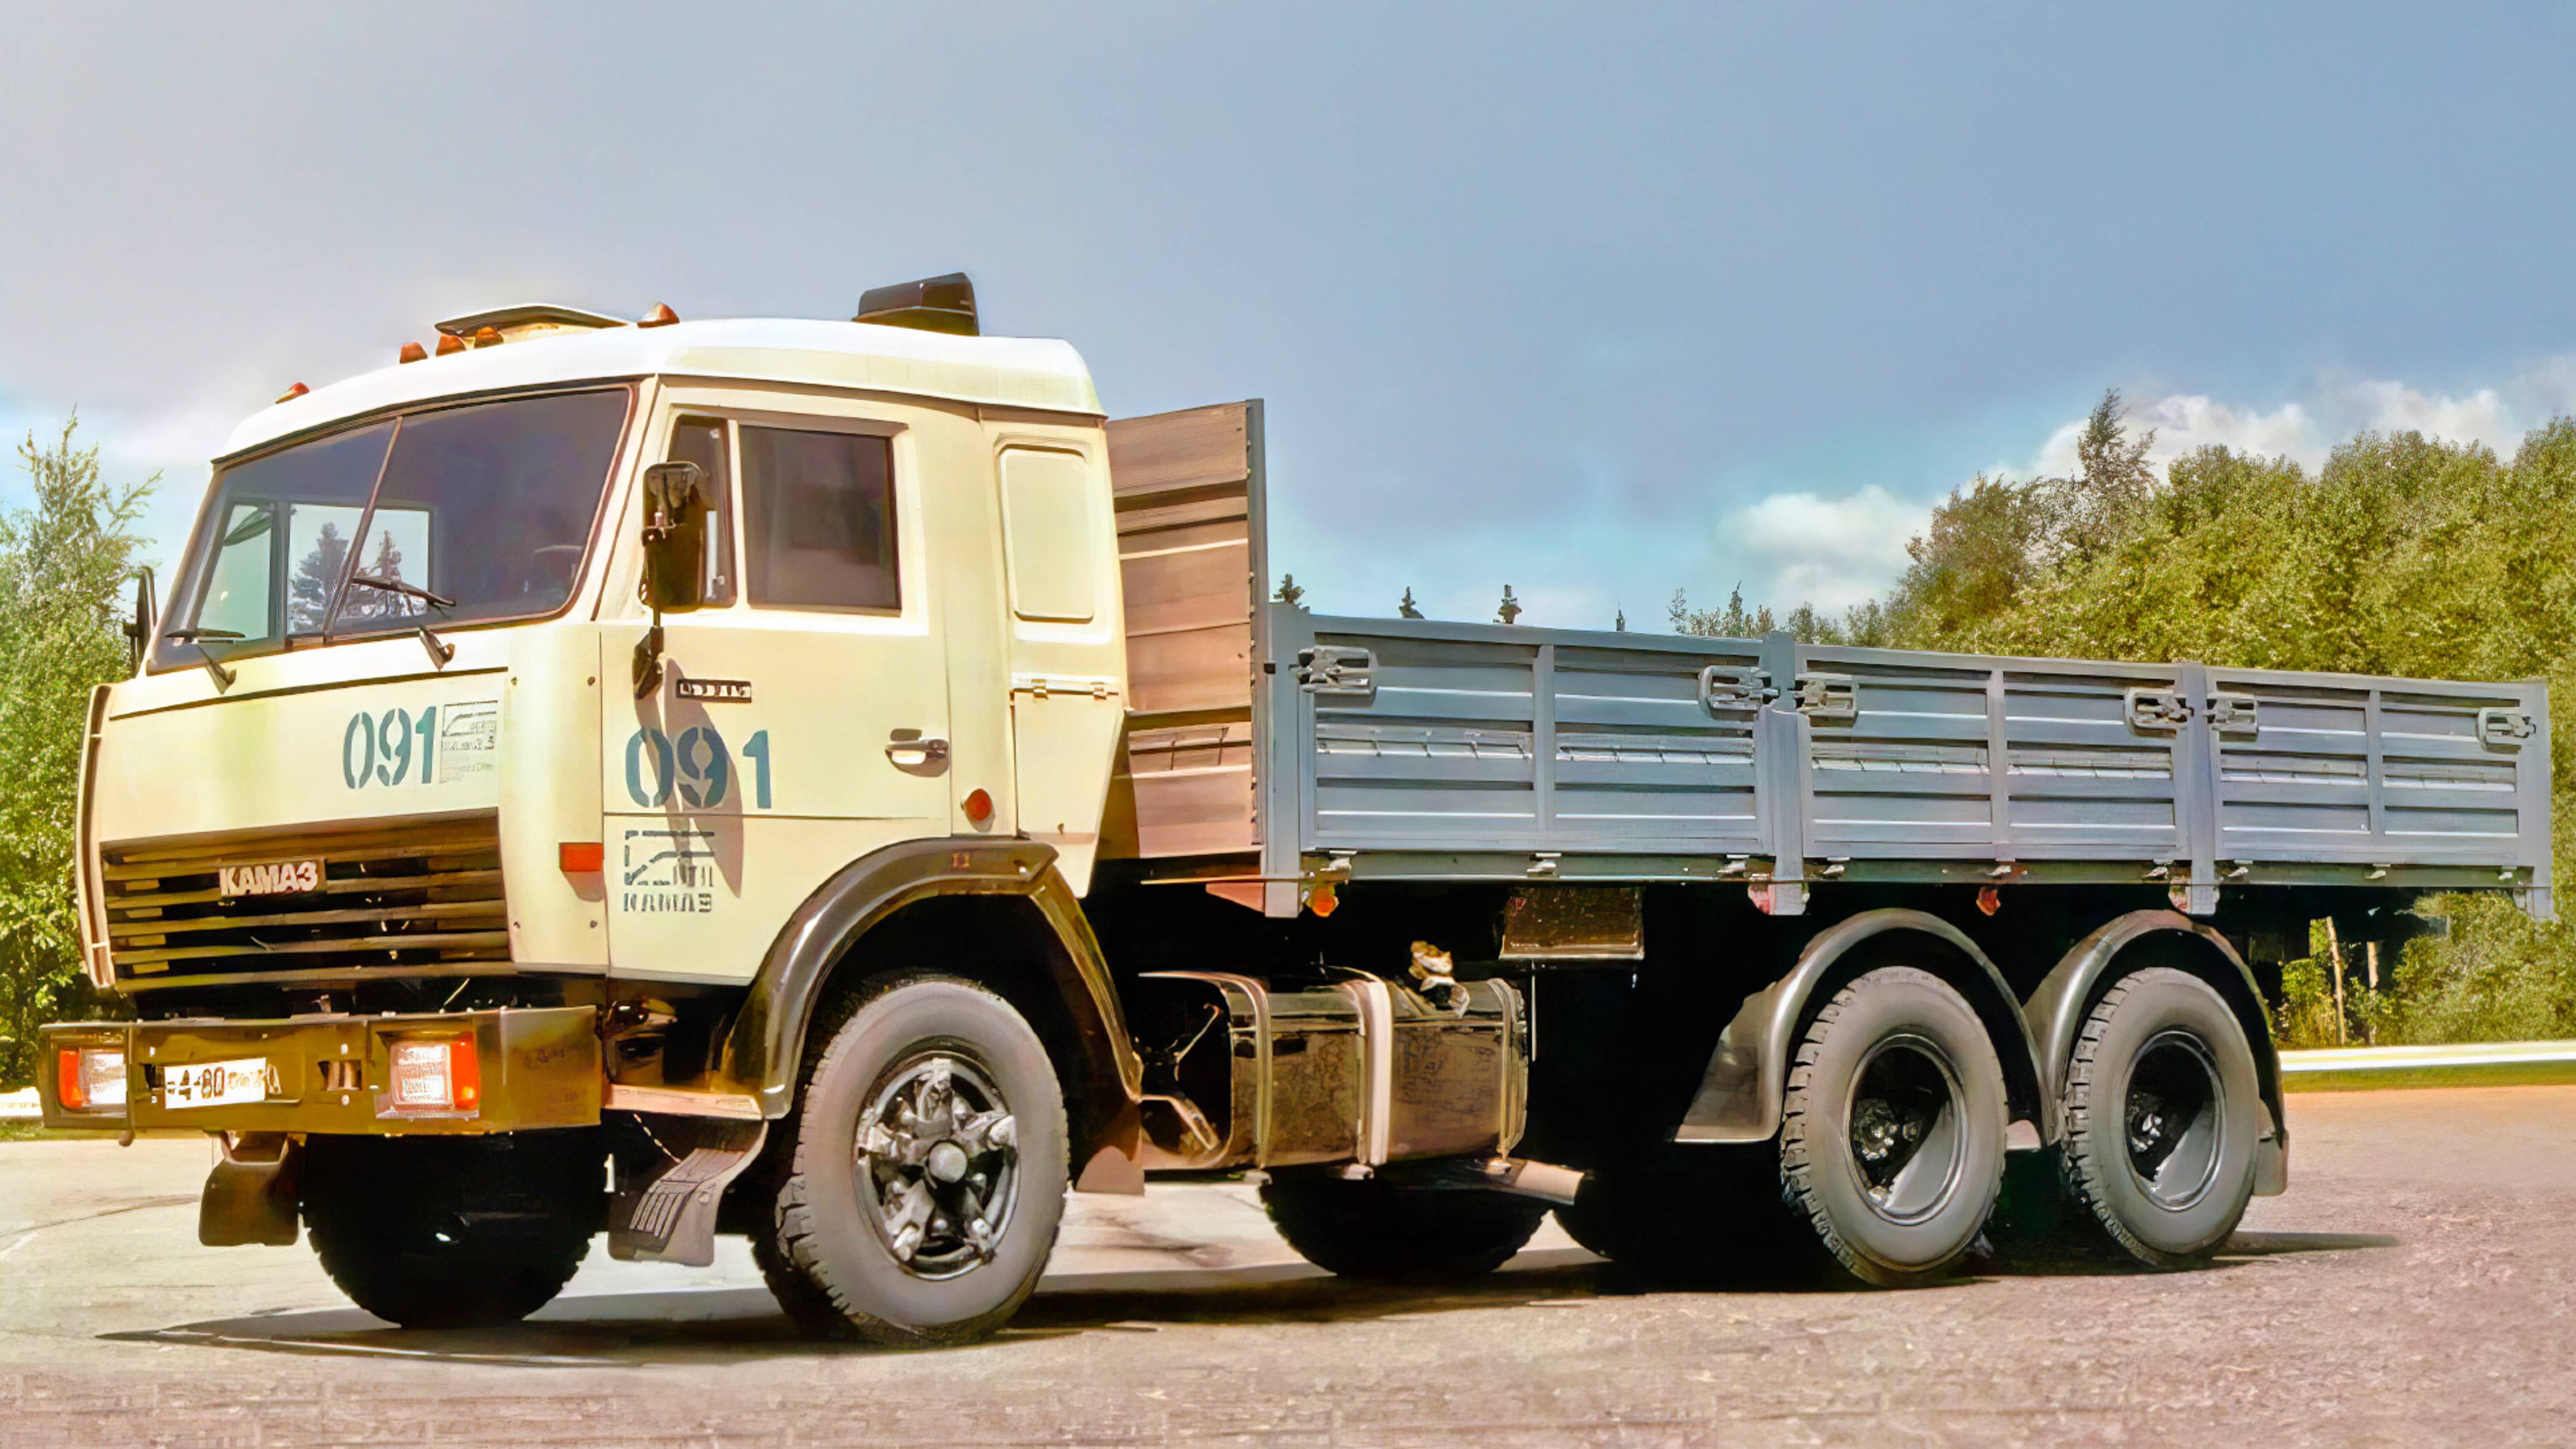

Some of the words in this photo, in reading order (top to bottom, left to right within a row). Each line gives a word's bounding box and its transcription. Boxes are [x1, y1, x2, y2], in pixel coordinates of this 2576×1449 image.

[343, 706, 436, 789] 091
[626, 726, 772, 809] 091
[219, 860, 318, 896] КАМАЗ
